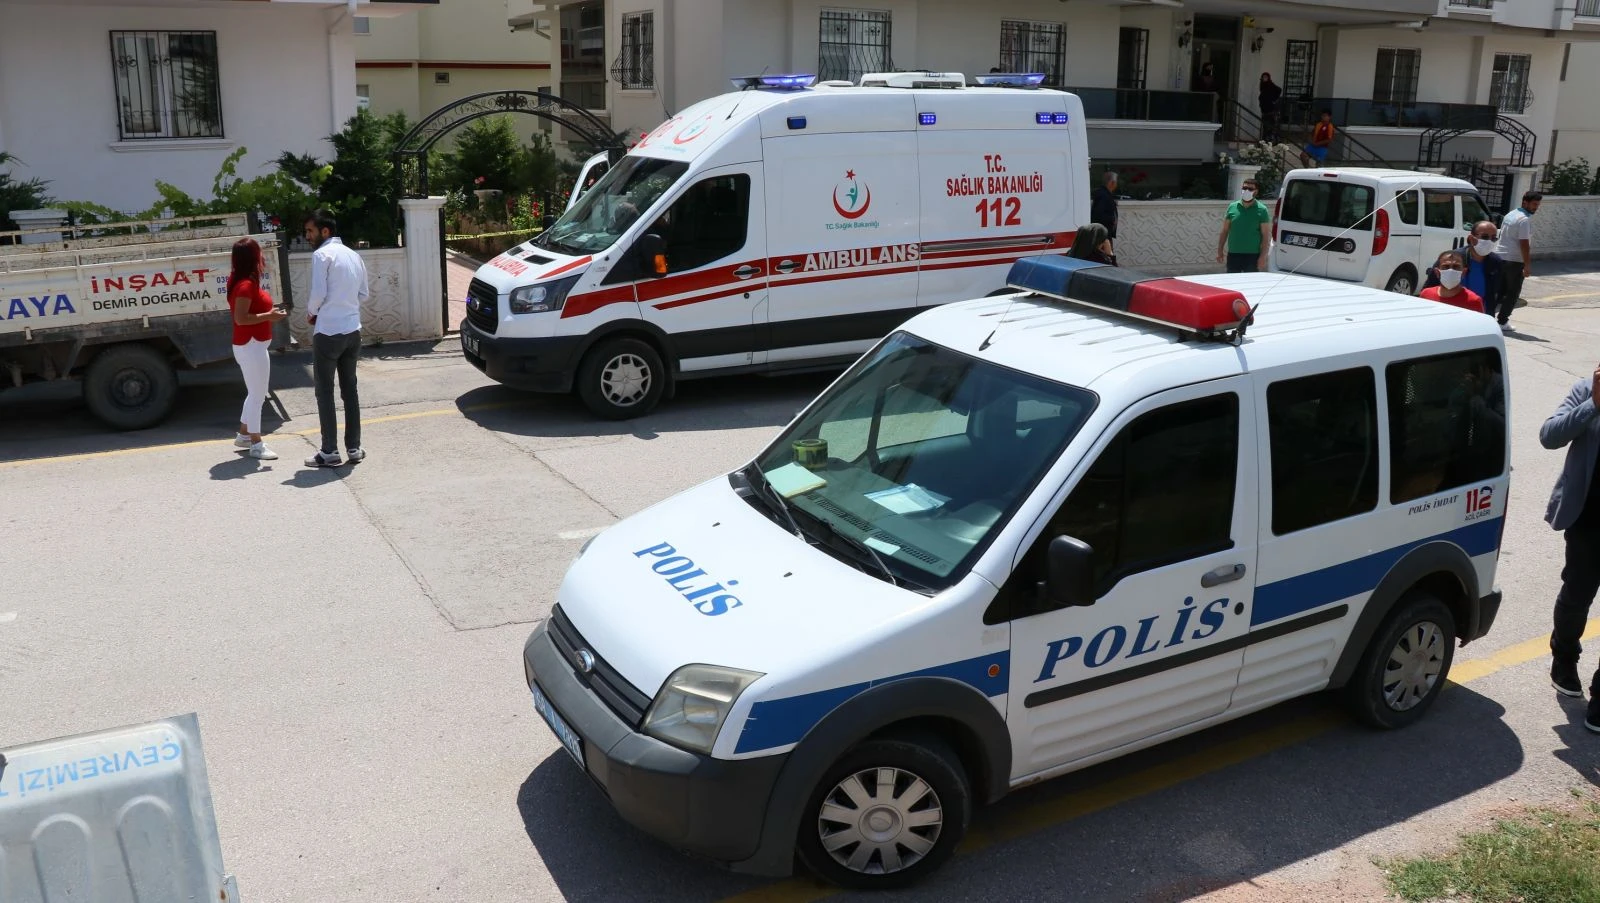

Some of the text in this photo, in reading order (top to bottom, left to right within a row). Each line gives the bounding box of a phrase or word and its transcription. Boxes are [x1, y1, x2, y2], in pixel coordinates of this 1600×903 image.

[984, 154, 1006, 173] T.C.
[946, 171, 1043, 197] SAĞLIK BAKANLIĞI
[975, 196, 1022, 228] 112
[803, 243, 920, 272] AMBULANS
[91, 269, 210, 294] İNŞAAT
[0, 294, 76, 321] AYA
[93, 290, 211, 311] DEMİR DOĞRAMA
[1408, 501, 1431, 516] POLİS
[1466, 486, 1493, 514] 112
[632, 541, 744, 617] POLİS
[1033, 596, 1230, 684] POLİS
[18, 737, 183, 798] ÇEVREMİZİ
